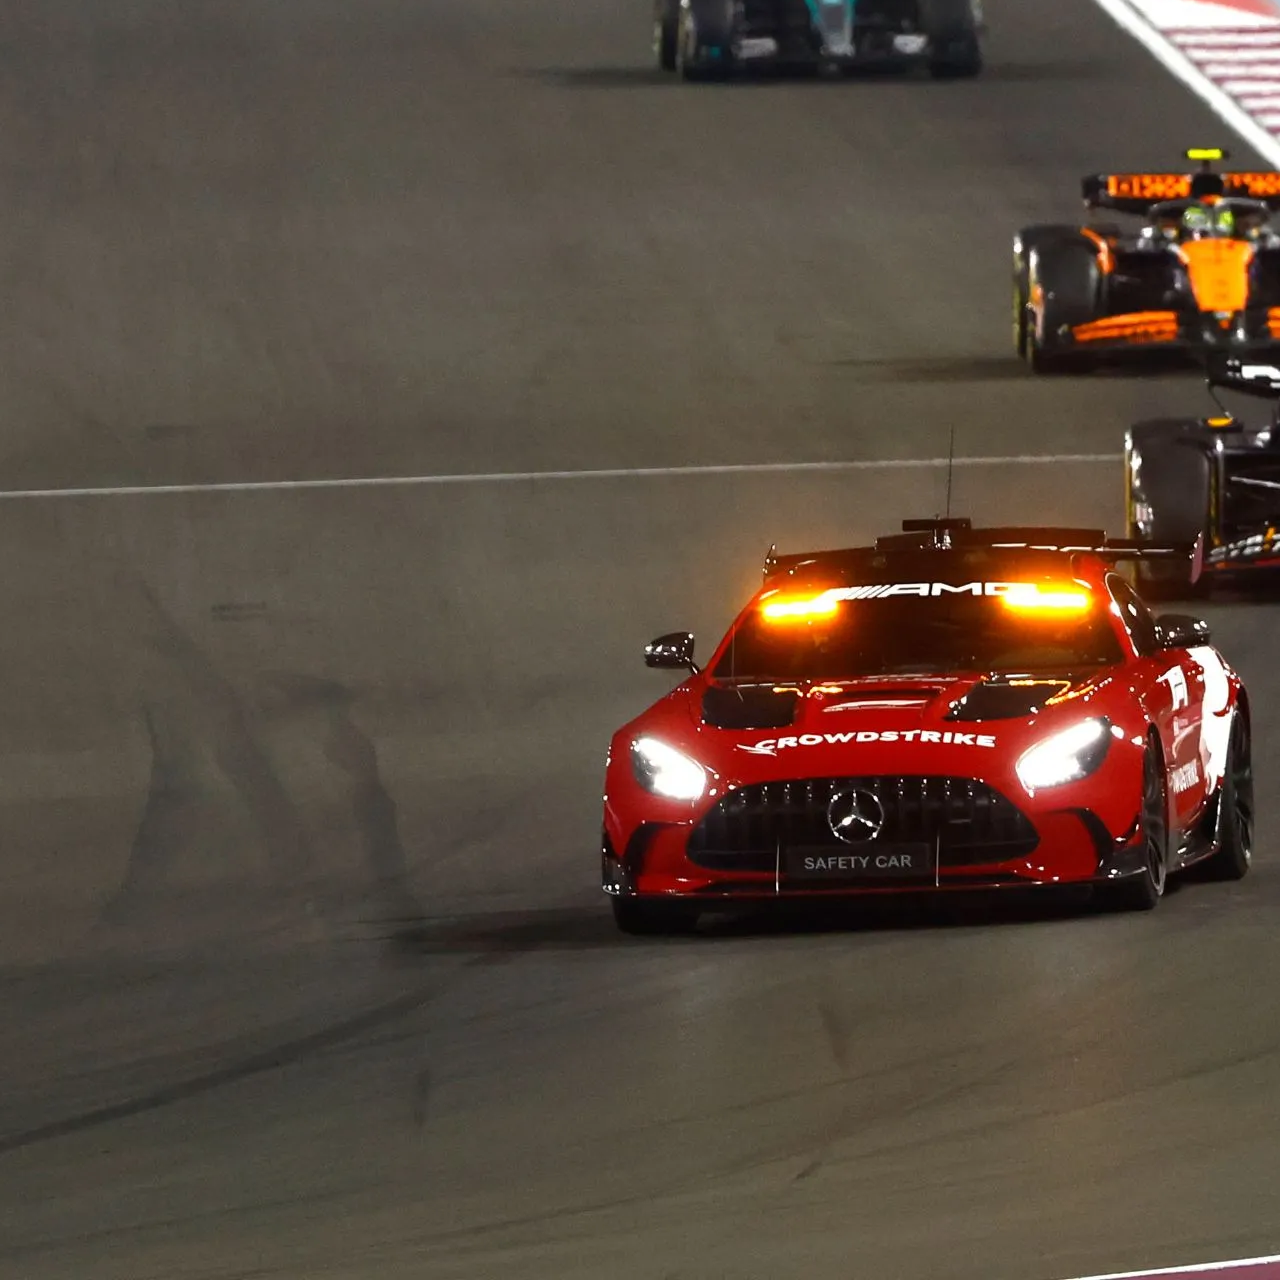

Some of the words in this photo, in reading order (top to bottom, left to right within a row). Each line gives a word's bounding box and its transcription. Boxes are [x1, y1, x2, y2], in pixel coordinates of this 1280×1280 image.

[748, 728, 996, 755] CROWDSTRIKE
[803, 855, 870, 870] SAFETY
[875, 853, 912, 869] CAR
